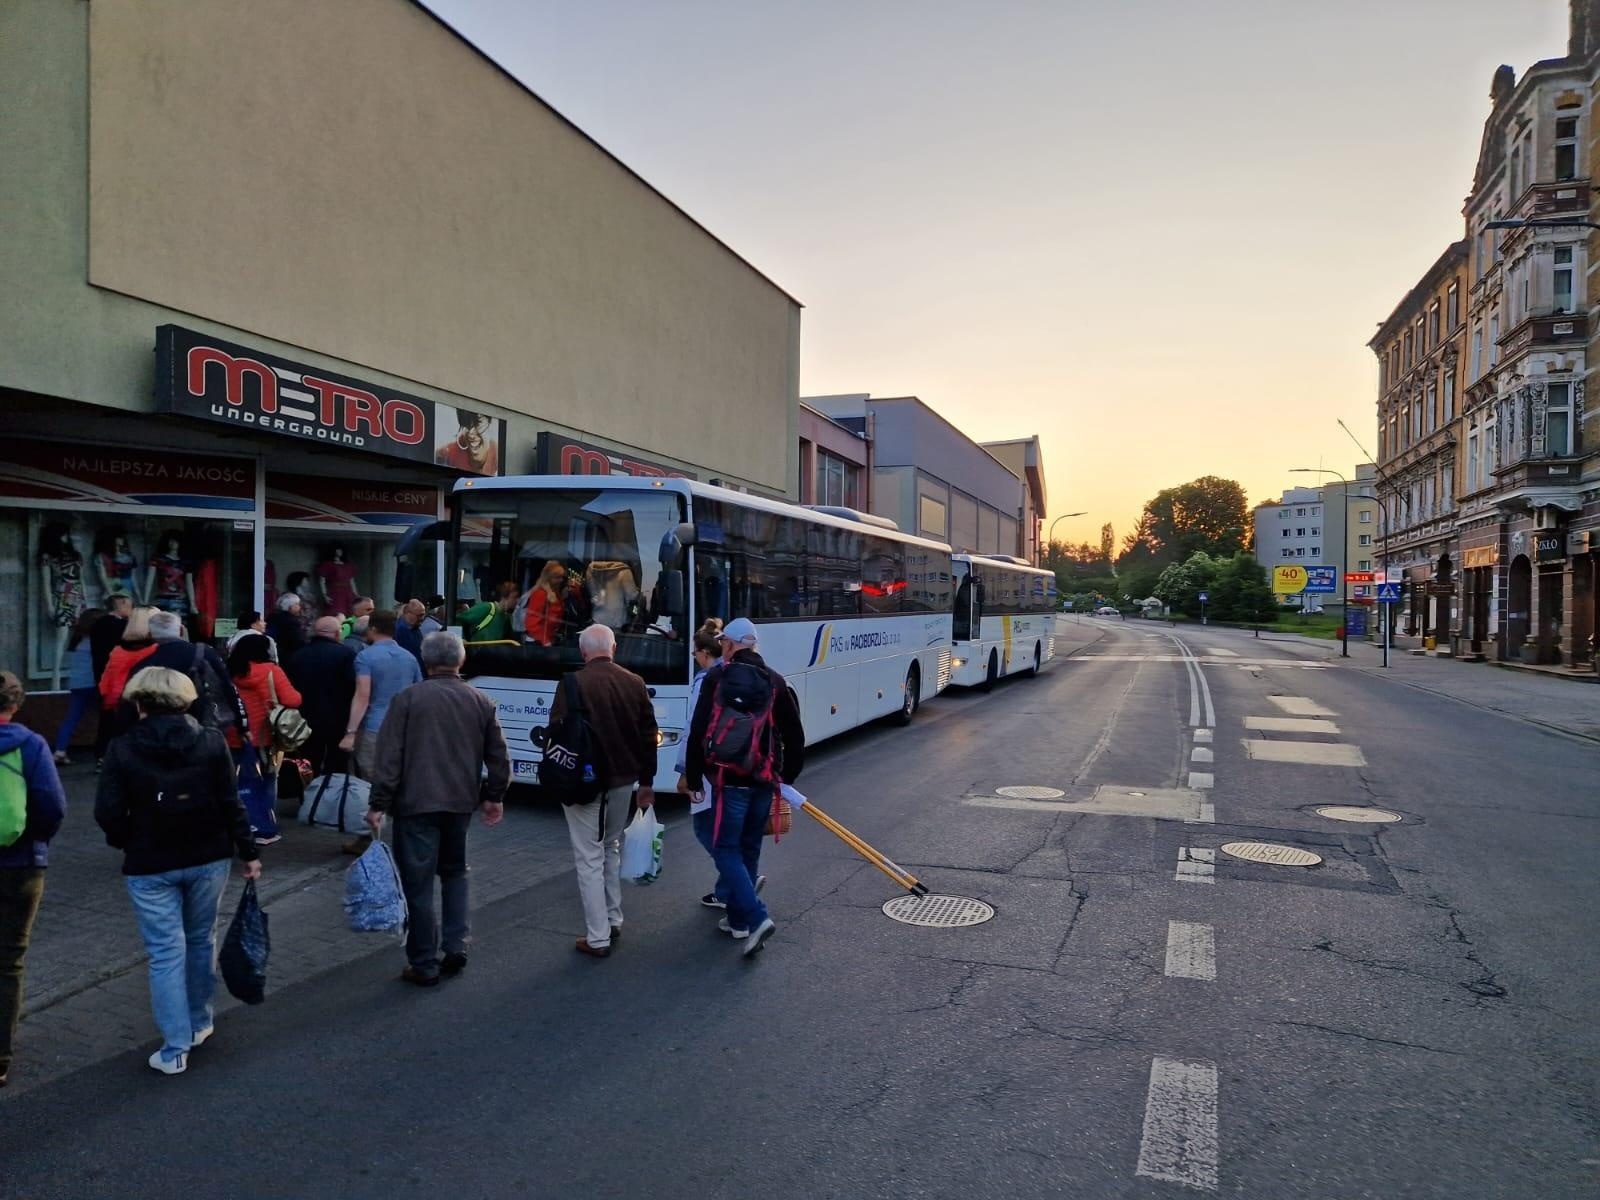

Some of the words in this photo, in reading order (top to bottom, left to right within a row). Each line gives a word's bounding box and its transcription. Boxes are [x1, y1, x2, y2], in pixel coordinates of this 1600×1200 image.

[187, 346, 425, 445] METRO
[210, 403, 365, 446] UNDERGROUND
[63, 456, 169, 478] NAJLEPSZA
[394, 491, 427, 505] CENY
[830, 636, 844, 653] PKS
[850, 632, 882, 650] RACIBORZU
[499, 703, 514, 714] PKS
